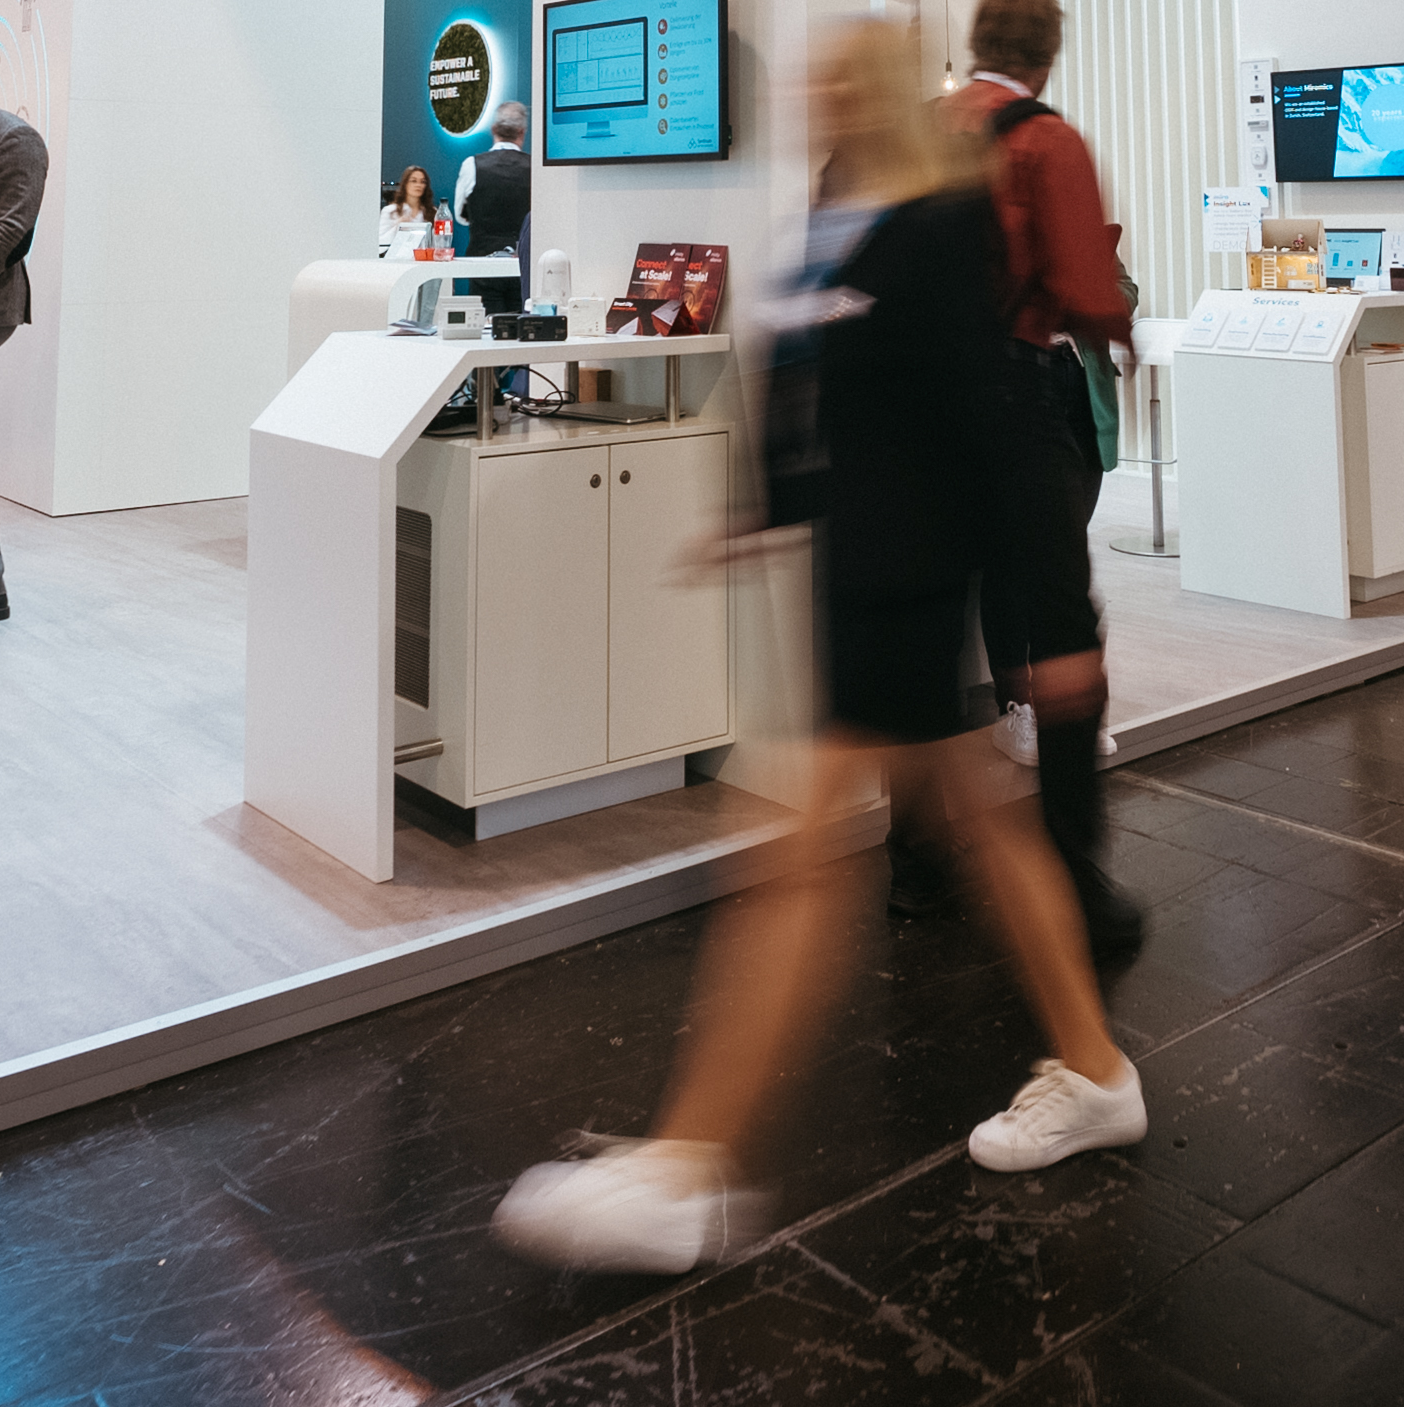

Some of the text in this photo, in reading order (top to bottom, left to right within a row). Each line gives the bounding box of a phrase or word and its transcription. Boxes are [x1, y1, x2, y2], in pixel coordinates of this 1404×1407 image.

[430, 56, 474, 71] EMPOWER A
[430, 69, 480, 86] SUSTAINABLE
[1371, 109, 1382, 117] 20
[1382, 109, 1401, 118] years
[636, 259, 667, 269] Connect
[639, 269, 672, 281] at Scale!
[1252, 296, 1300, 307] Services
